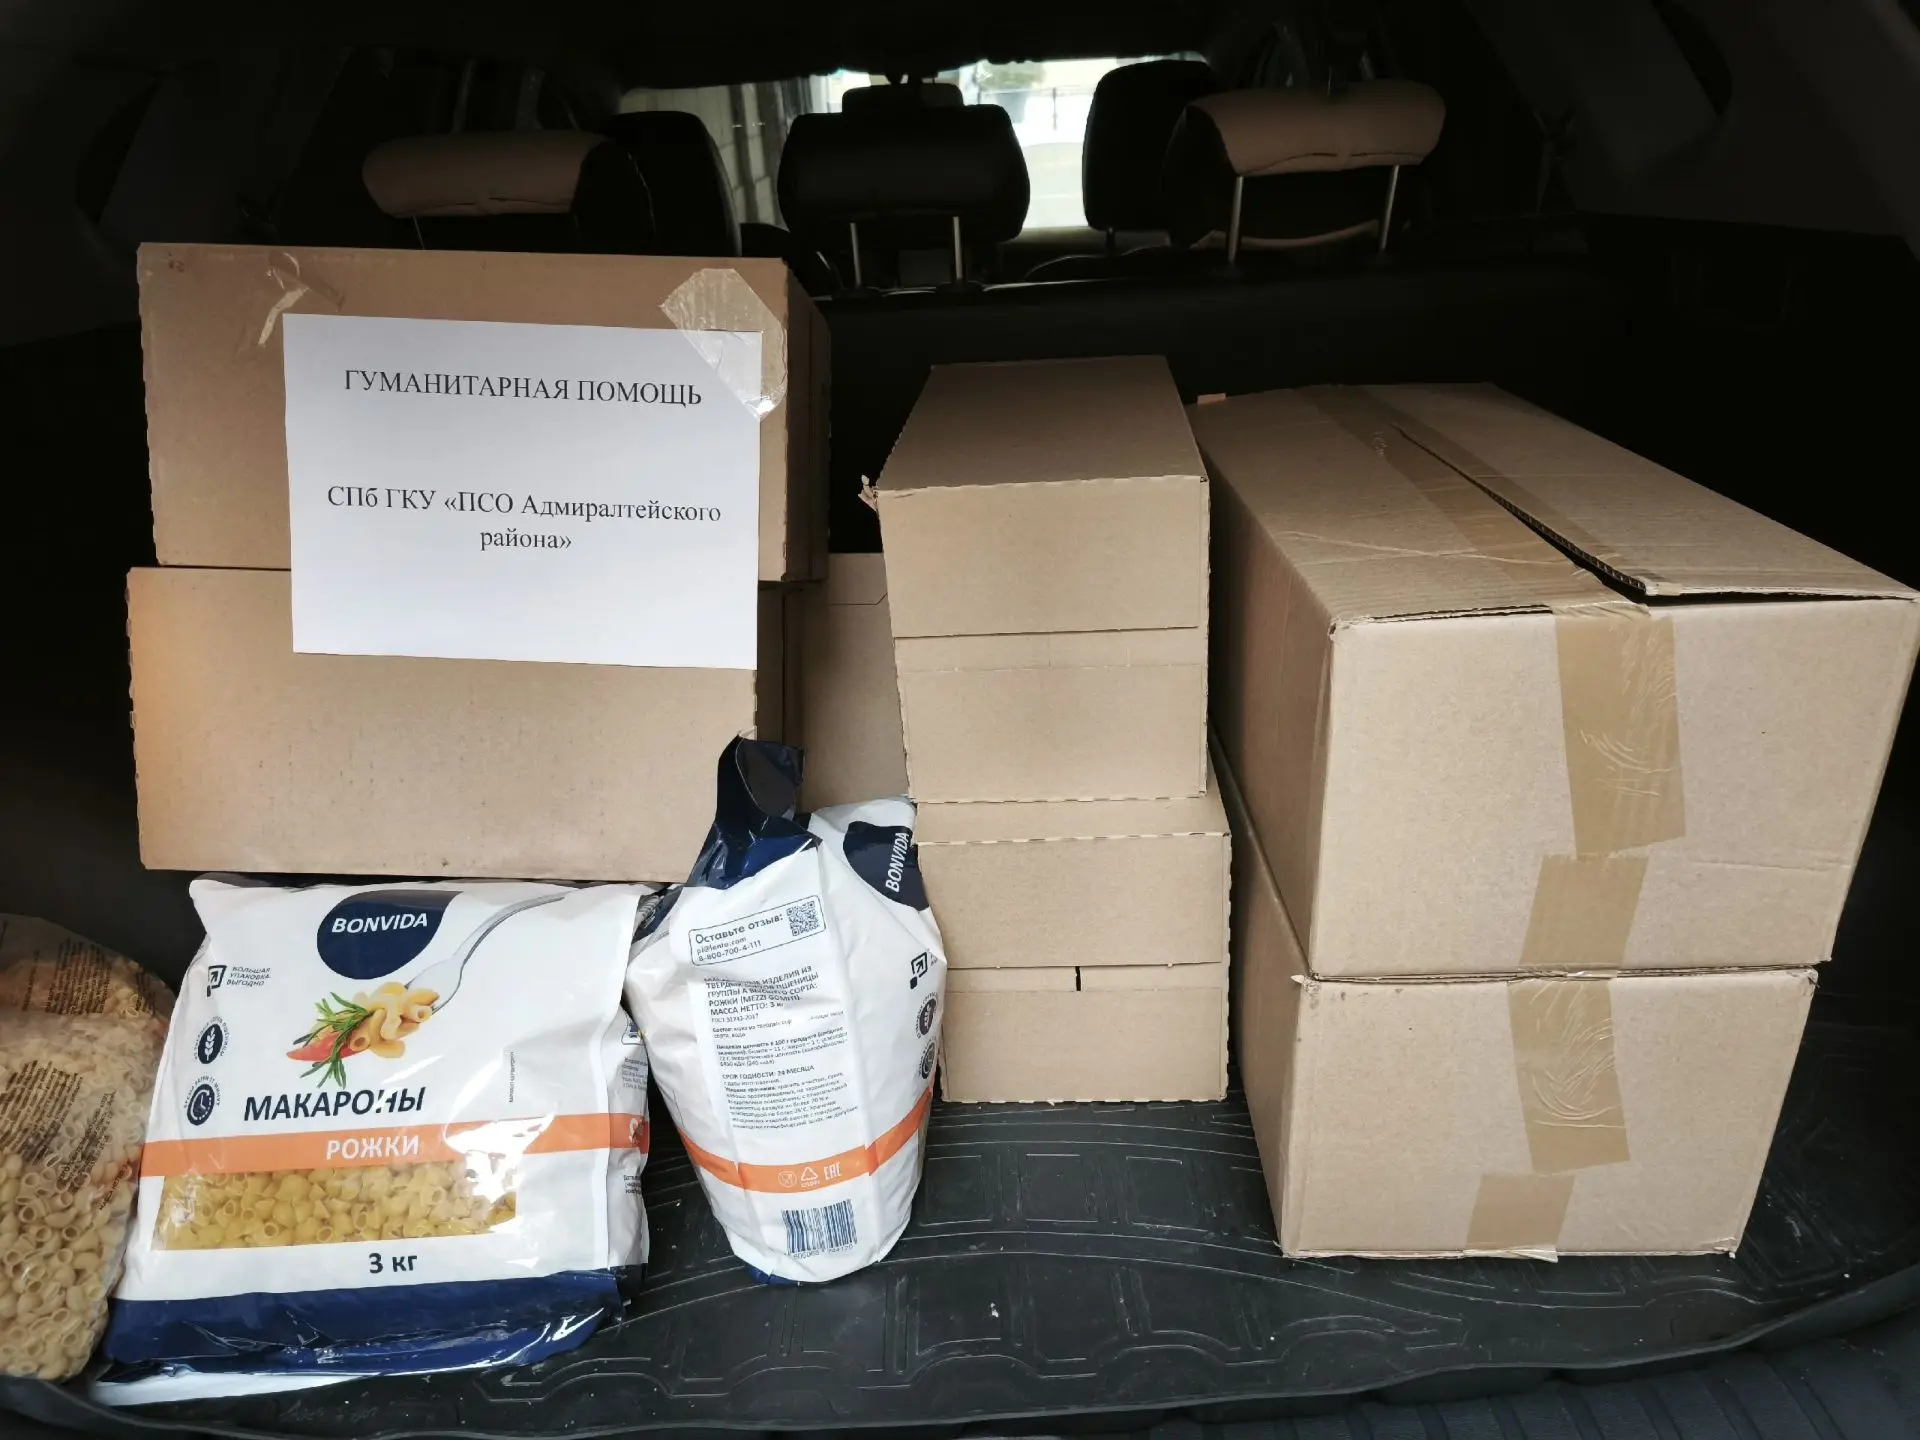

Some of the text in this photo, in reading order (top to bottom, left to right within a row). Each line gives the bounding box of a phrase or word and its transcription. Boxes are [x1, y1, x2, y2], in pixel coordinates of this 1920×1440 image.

[344, 370, 702, 407] ГУМАНИТАРНАЯ ПОМОЩЬ
[327, 485, 722, 523] СПб ГКУ «ПСО Адмиралтейского
[479, 528, 572, 551] района»
[885, 831, 911, 893] BONVIDA
[331, 912, 428, 934] BONVIDA
[695, 913, 784, 944] Оставьте отзыв:
[762, 969, 800, 984] ИЗДЕЛИЯ
[708, 988, 740, 998] ГРУППЫ
[710, 1007, 738, 1015] МАССА
[740, 1003, 768, 1012] НЕТТО:
[243, 1086, 426, 1121] МАКАРОНЫ
[325, 1134, 420, 1161] РОЖКИ
[368, 1252, 418, 1274] 3 кг
